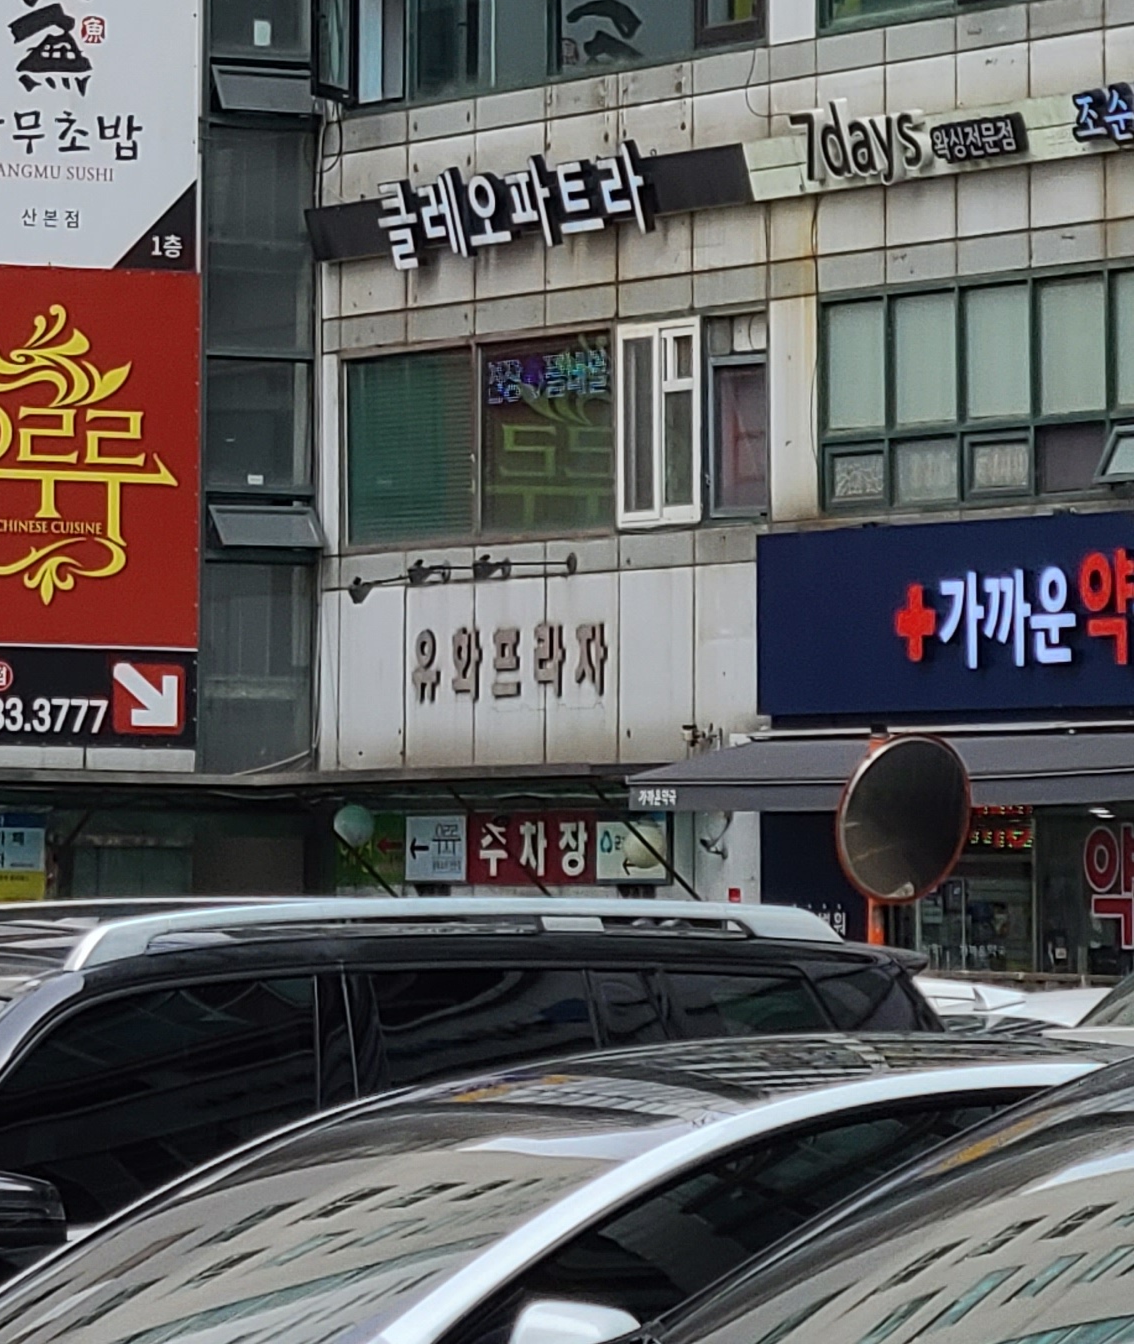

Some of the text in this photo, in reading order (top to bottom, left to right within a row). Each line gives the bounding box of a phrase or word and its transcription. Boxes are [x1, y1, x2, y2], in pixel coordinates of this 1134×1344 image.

[789, 97, 926, 186] 7days
[932, 117, 1018, 161] 왁싱전문점
[66, 166, 114, 183] SUSHI
[21, 208, 80, 230] 산본점
[377, 139, 646, 271] 클레오파트라
[151, 234, 183, 257] 1층
[50, 519, 102, 536] CUISINE
[479, 819, 589, 878] 주차장
